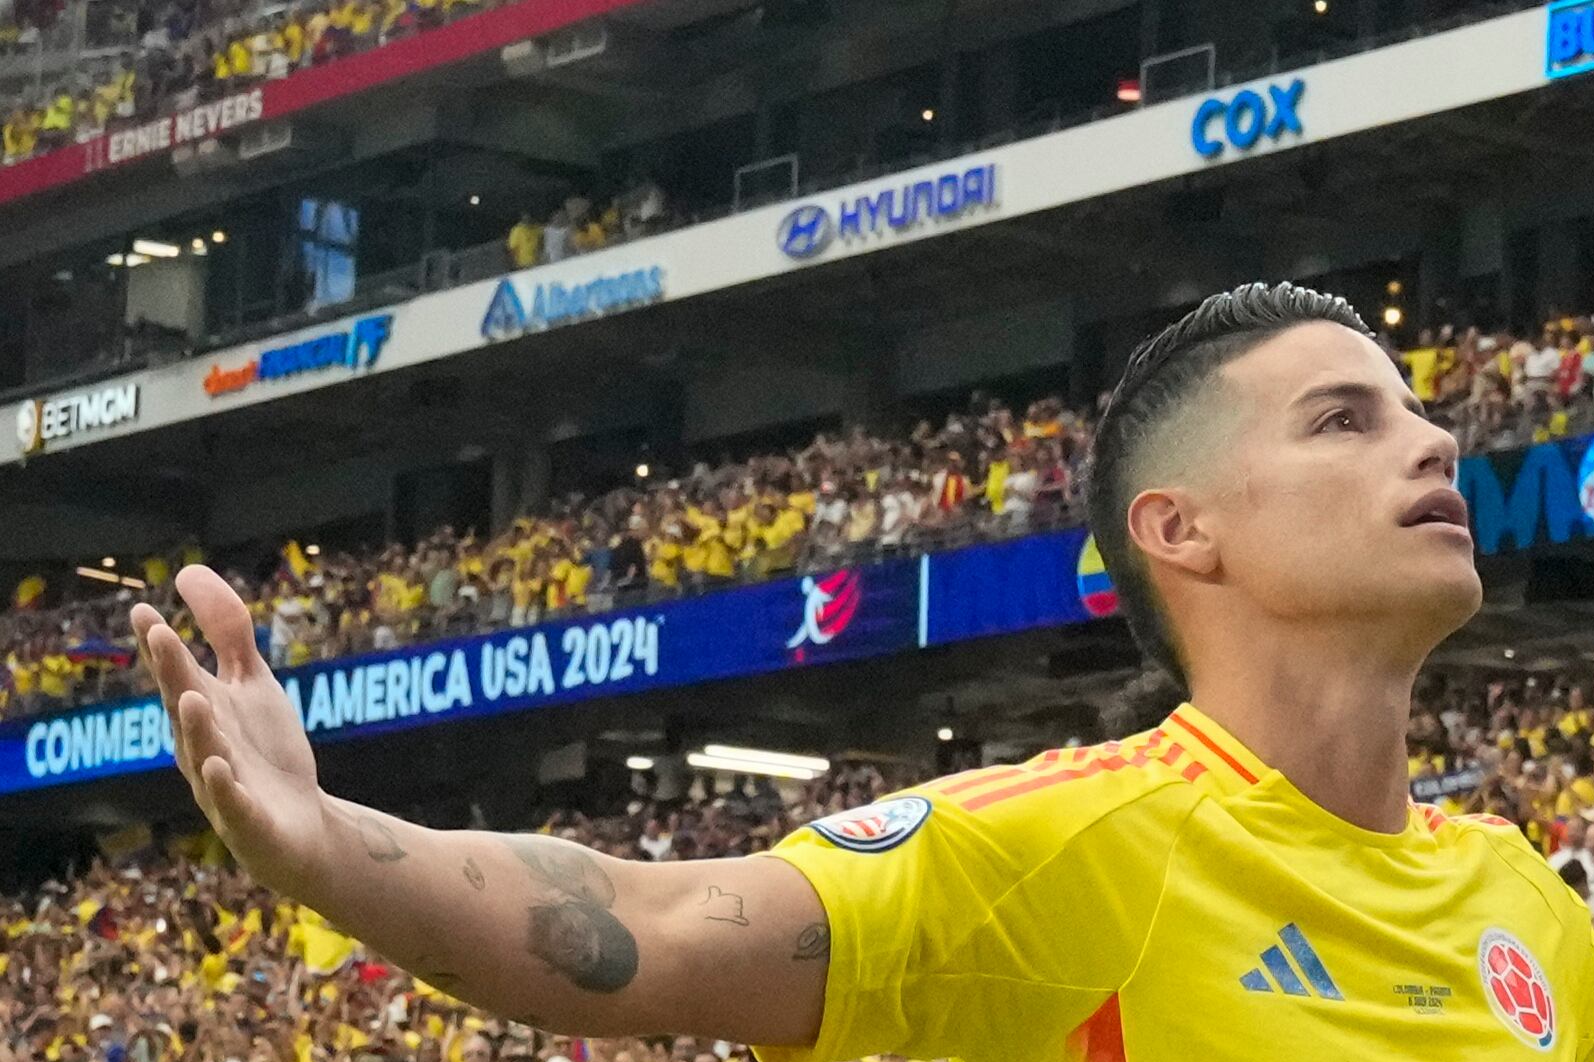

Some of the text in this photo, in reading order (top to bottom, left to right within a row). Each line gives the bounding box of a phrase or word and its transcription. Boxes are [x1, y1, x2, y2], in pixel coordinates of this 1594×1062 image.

[108, 88, 263, 163] ERNIE NEVERS
[1192, 79, 1306, 156] COX
[840, 163, 996, 239] HYUNDAI
[306, 648, 473, 732] AMERICA
[481, 631, 555, 700] USA
[562, 616, 659, 689] 2024
